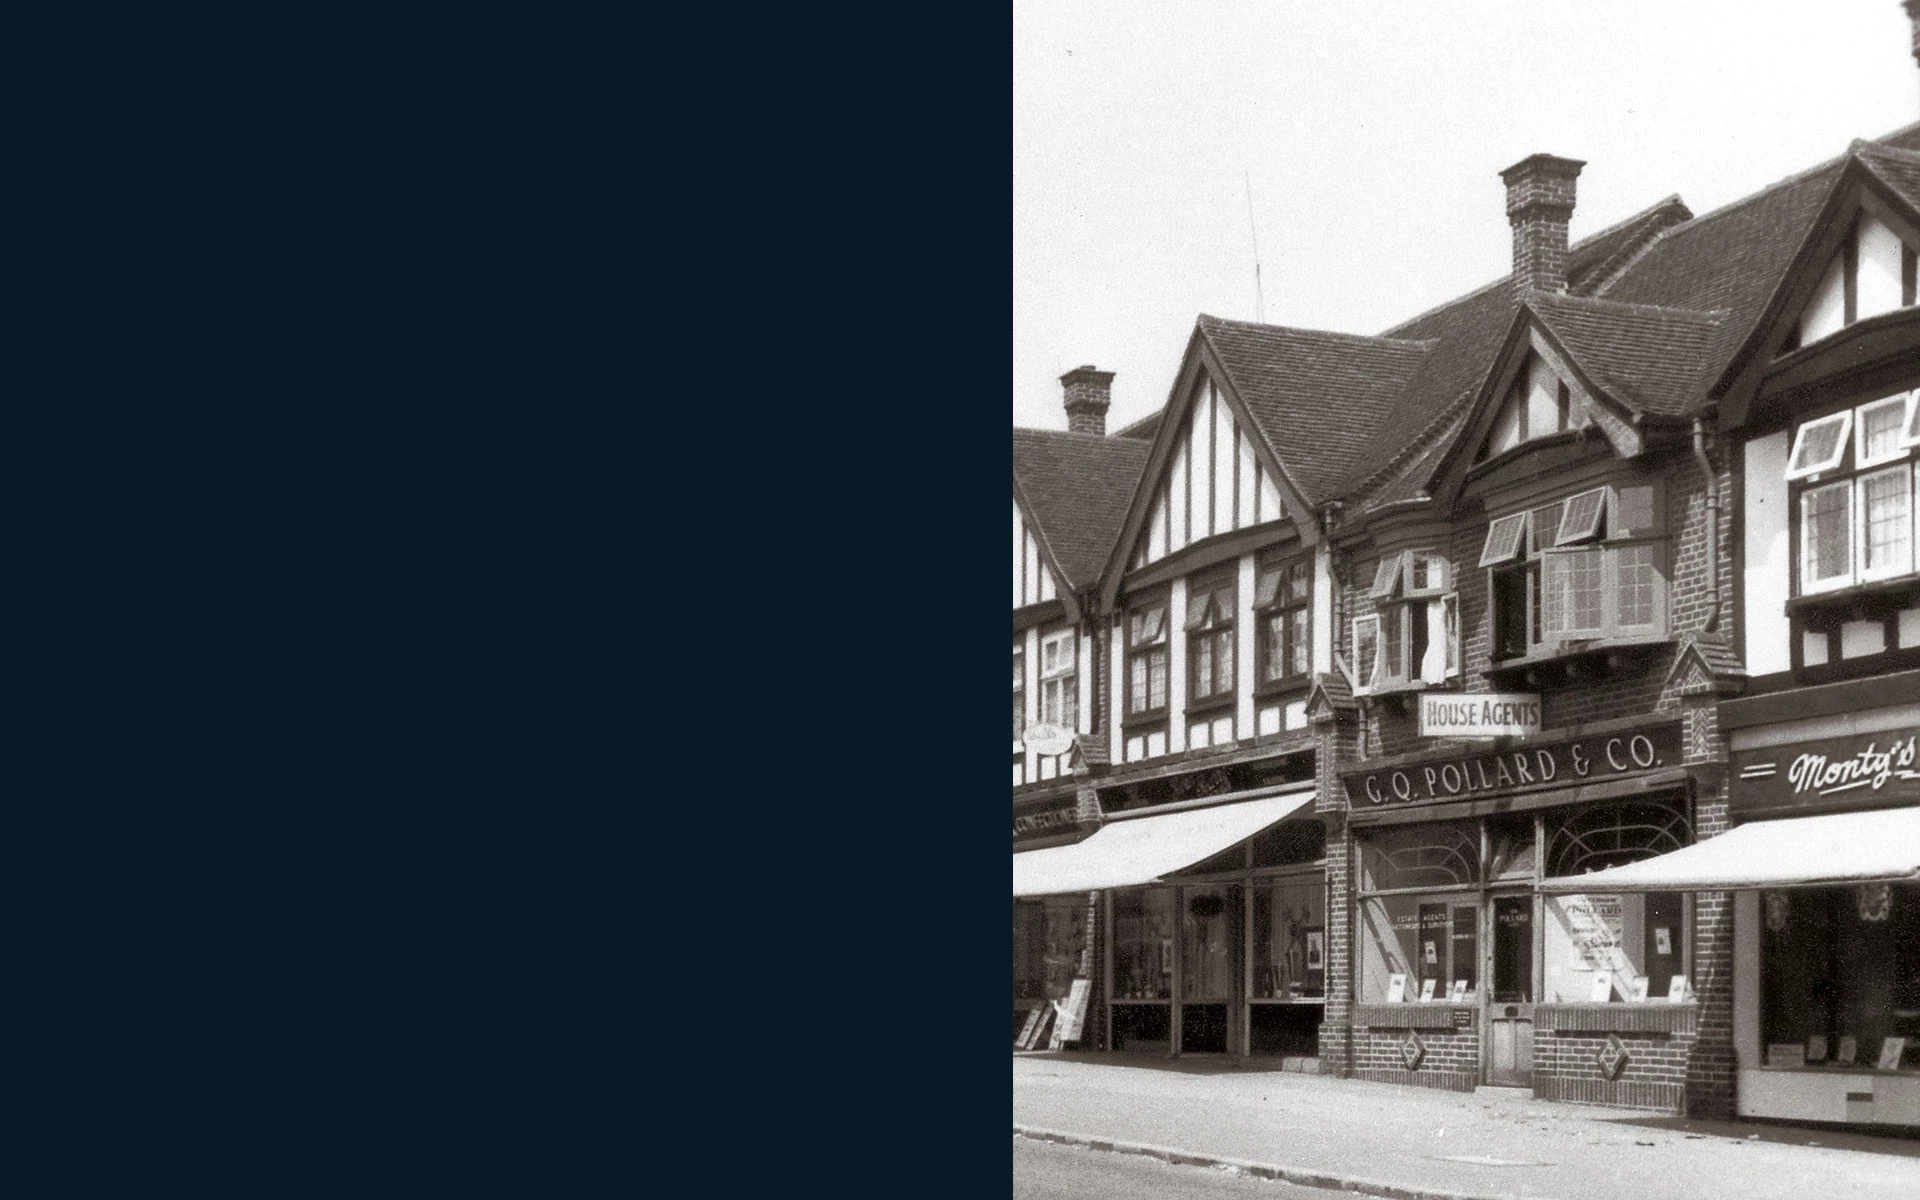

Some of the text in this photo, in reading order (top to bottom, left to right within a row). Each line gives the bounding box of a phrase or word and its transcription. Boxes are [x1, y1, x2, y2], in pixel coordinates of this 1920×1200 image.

[1427, 700, 1539, 727] HOUSE AGENTS
[1365, 734, 1664, 804] G. Q. POLLARD & CO.
[1788, 735, 1917, 794] Monty's
[1422, 913, 1446, 921] AGENTS
